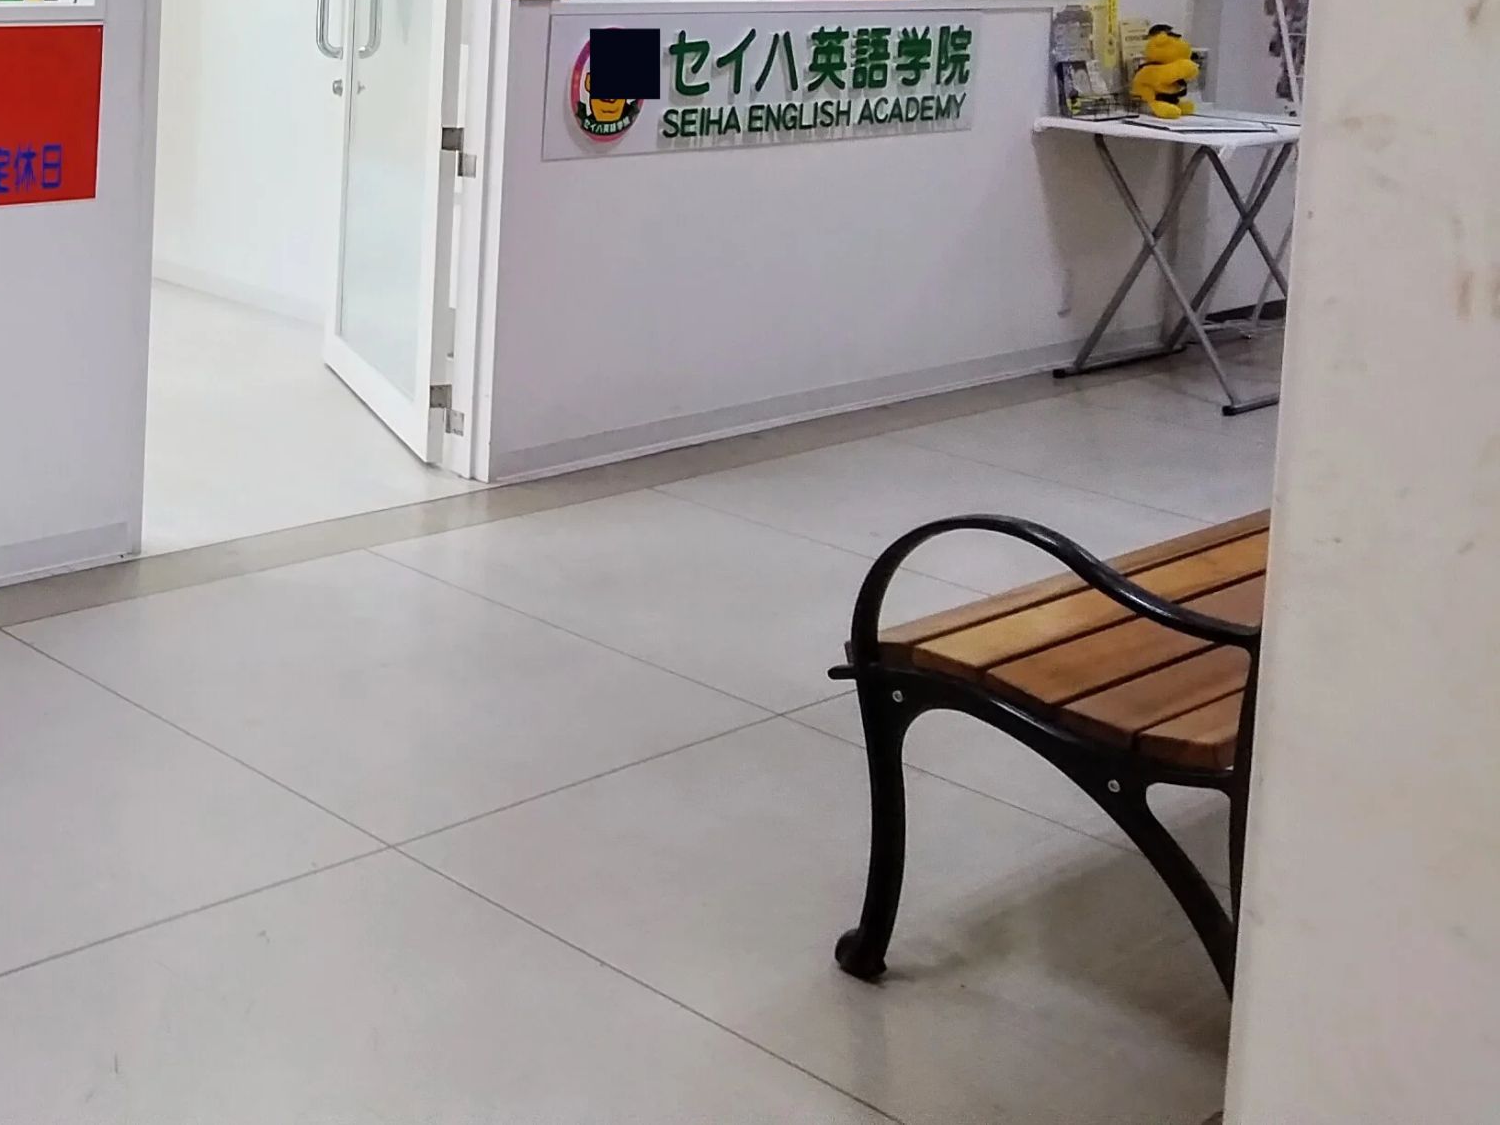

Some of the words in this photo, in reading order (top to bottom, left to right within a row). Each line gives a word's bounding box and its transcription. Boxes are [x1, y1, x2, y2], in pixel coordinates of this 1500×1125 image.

[668, 24, 973, 97] セイハ英語学院
[662, 106, 742, 138] SEIHA
[747, 100, 851, 132] ENGLISH
[857, 92, 968, 125] ACADEMY
